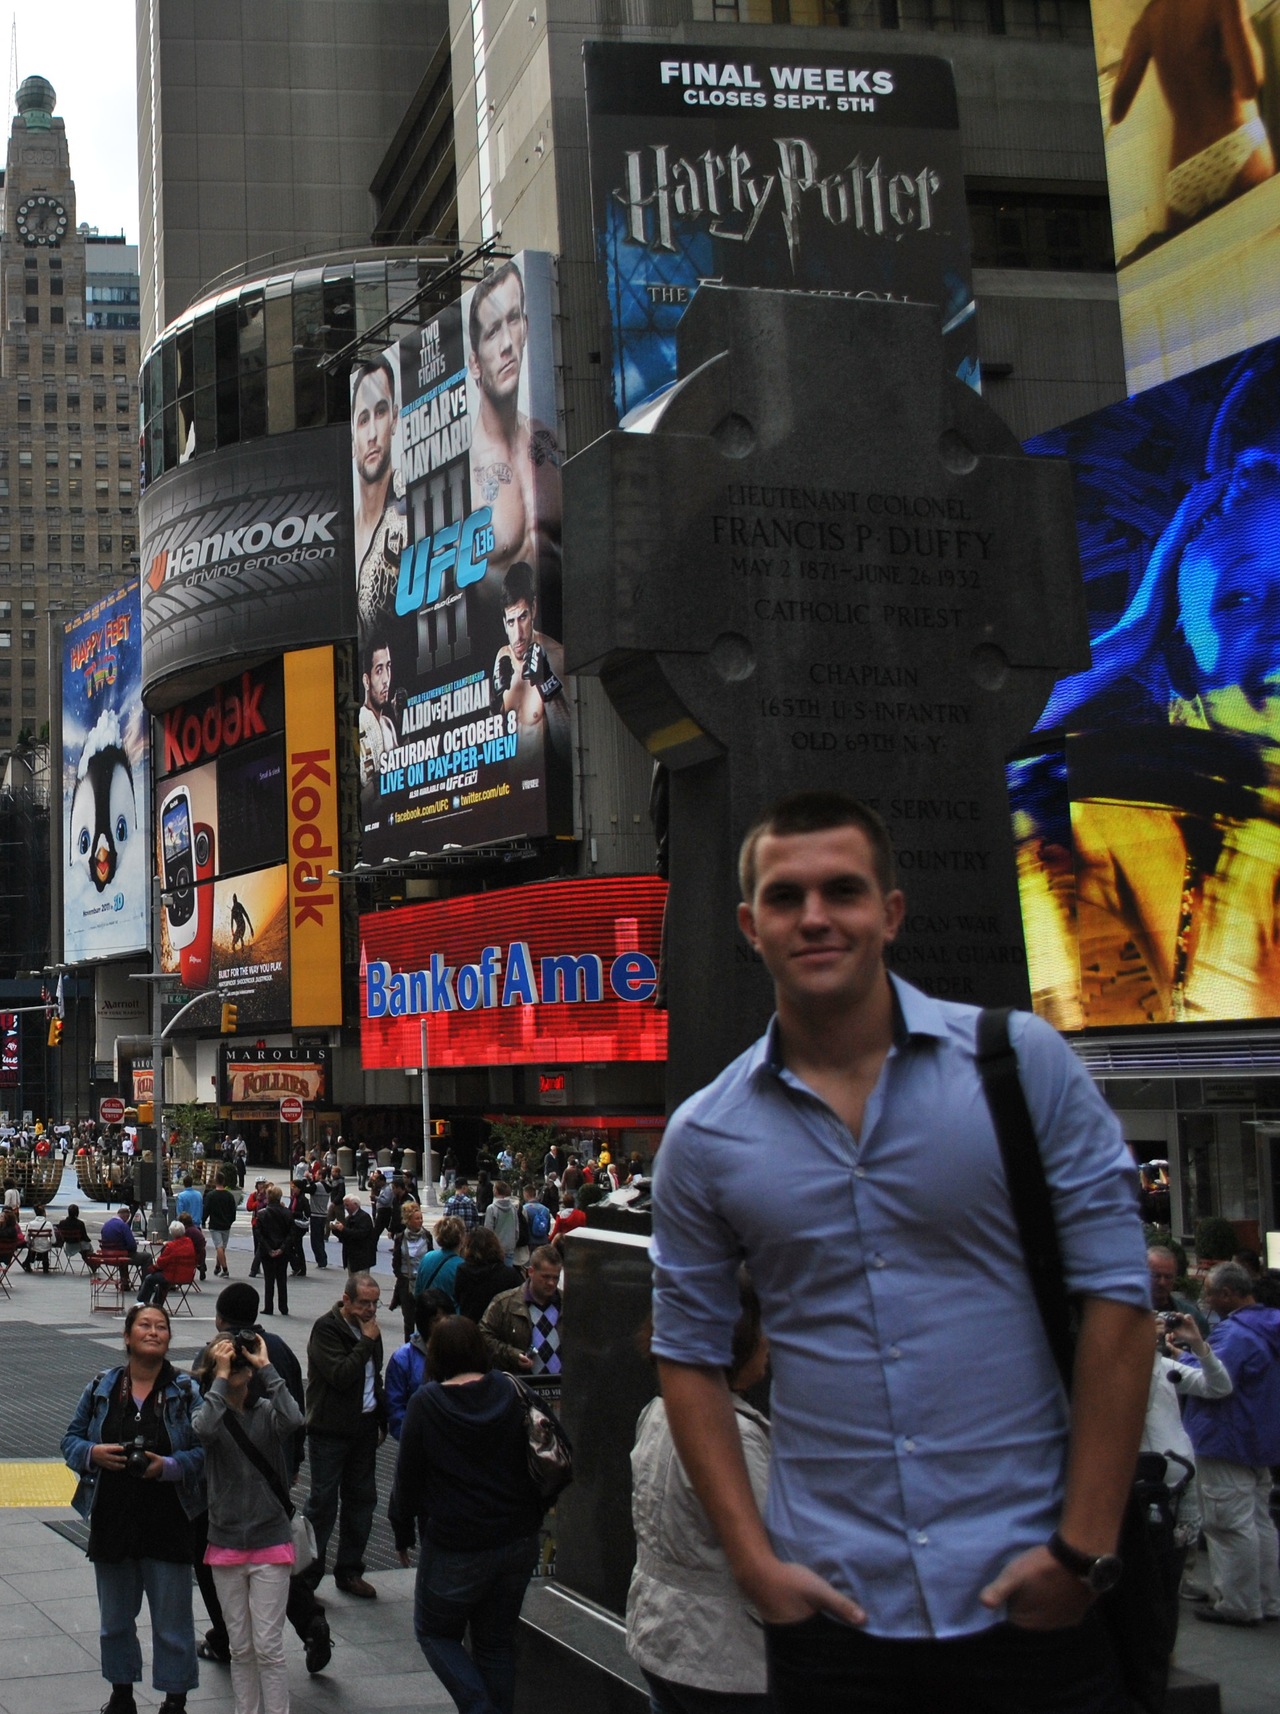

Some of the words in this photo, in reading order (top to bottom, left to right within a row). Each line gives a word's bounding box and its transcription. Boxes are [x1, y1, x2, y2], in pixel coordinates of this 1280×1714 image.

[660, 60, 761, 88] FINAL
[770, 66, 894, 95] WEEKS
[683, 88, 766, 109] CLOSES
[773, 93, 831, 111] SEPT.
[836, 96, 875, 113] 5TH
[612, 144, 775, 254] Harry
[772, 137, 942, 276] Potter
[647, 286, 689, 304] THE
[420, 319, 439, 347] TWO
[419, 340, 440, 366] TITLE
[418, 356, 446, 388] FIGHTS
[402, 389, 452, 451] EDGAR
[450, 384, 468, 418] VS
[400, 413, 473, 484] MAYNARD
[727, 483, 860, 513] LIEUTENANT
[867, 494, 971, 521] COLONEL
[474, 528, 496, 558] 136
[711, 515, 846, 551] FRANCIS
[888, 526, 996, 560] DUFFY
[185, 561, 240, 588] driving
[244, 546, 336, 571] emotion
[394, 506, 493, 617] UFC
[730, 556, 775, 578] MAY
[104, 611, 132, 644] FEET
[753, 600, 871, 625] CATHOLIC
[883, 605, 964, 629] PRIEST
[70, 625, 103, 674] HAPPY
[83, 653, 118, 698] TWO
[809, 663, 919, 688] CHAPLAIN
[163, 671, 268, 773] Kodak
[401, 702, 432, 737] ALDO
[441, 679, 492, 722] FLORIAN
[380, 733, 441, 775] SATURDAY
[443, 713, 504, 751] OCTOBER
[507, 710, 517, 733] 8
[791, 731, 838, 751] OLD
[380, 767, 405, 796] LIVE
[407, 762, 425, 785] ON
[427, 733, 518, 780] PAY-PER-VIEW
[395, 798, 449, 824] facebook.com/UFC
[461, 783, 510, 807] twitter.com/ufc
[890, 800, 982, 821] SERVICE
[289, 748, 335, 929] Kodak
[230, 967, 239, 977] FOR
[260, 963, 270, 973] YOU
[366, 953, 458, 1018] Bank
[457, 946, 502, 1011] of
[102, 1000, 139, 1010] Marriott
[226, 1050, 326, 1060] MARQUIS
[241, 1072, 310, 1101] FOLLIES
